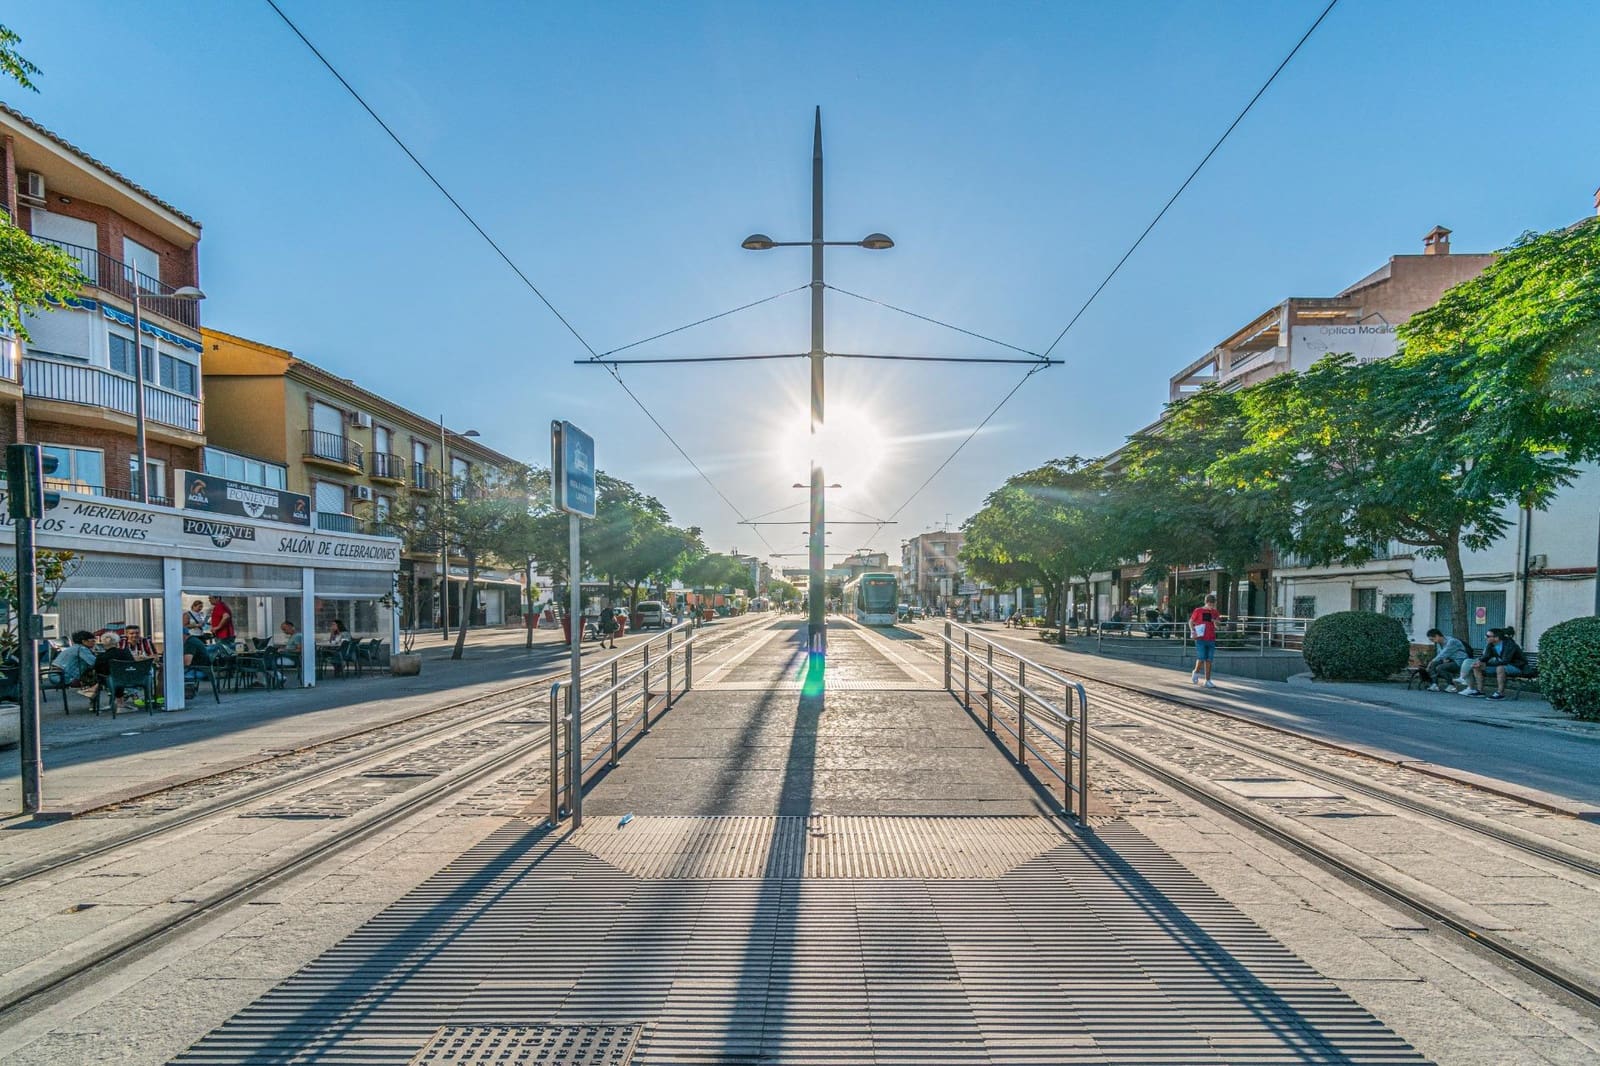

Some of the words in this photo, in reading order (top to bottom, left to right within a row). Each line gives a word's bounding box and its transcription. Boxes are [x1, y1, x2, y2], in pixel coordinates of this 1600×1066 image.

[229, 489, 278, 506] PONIENTE
[73, 503, 155, 525] MERIENDAS
[80, 522, 148, 540] RACIONES
[187, 520, 254, 539] PONIENTE
[278, 536, 315, 555] SALÓN
[317, 541, 332, 556] DE
[333, 543, 396, 560] CELEBRACIONES
